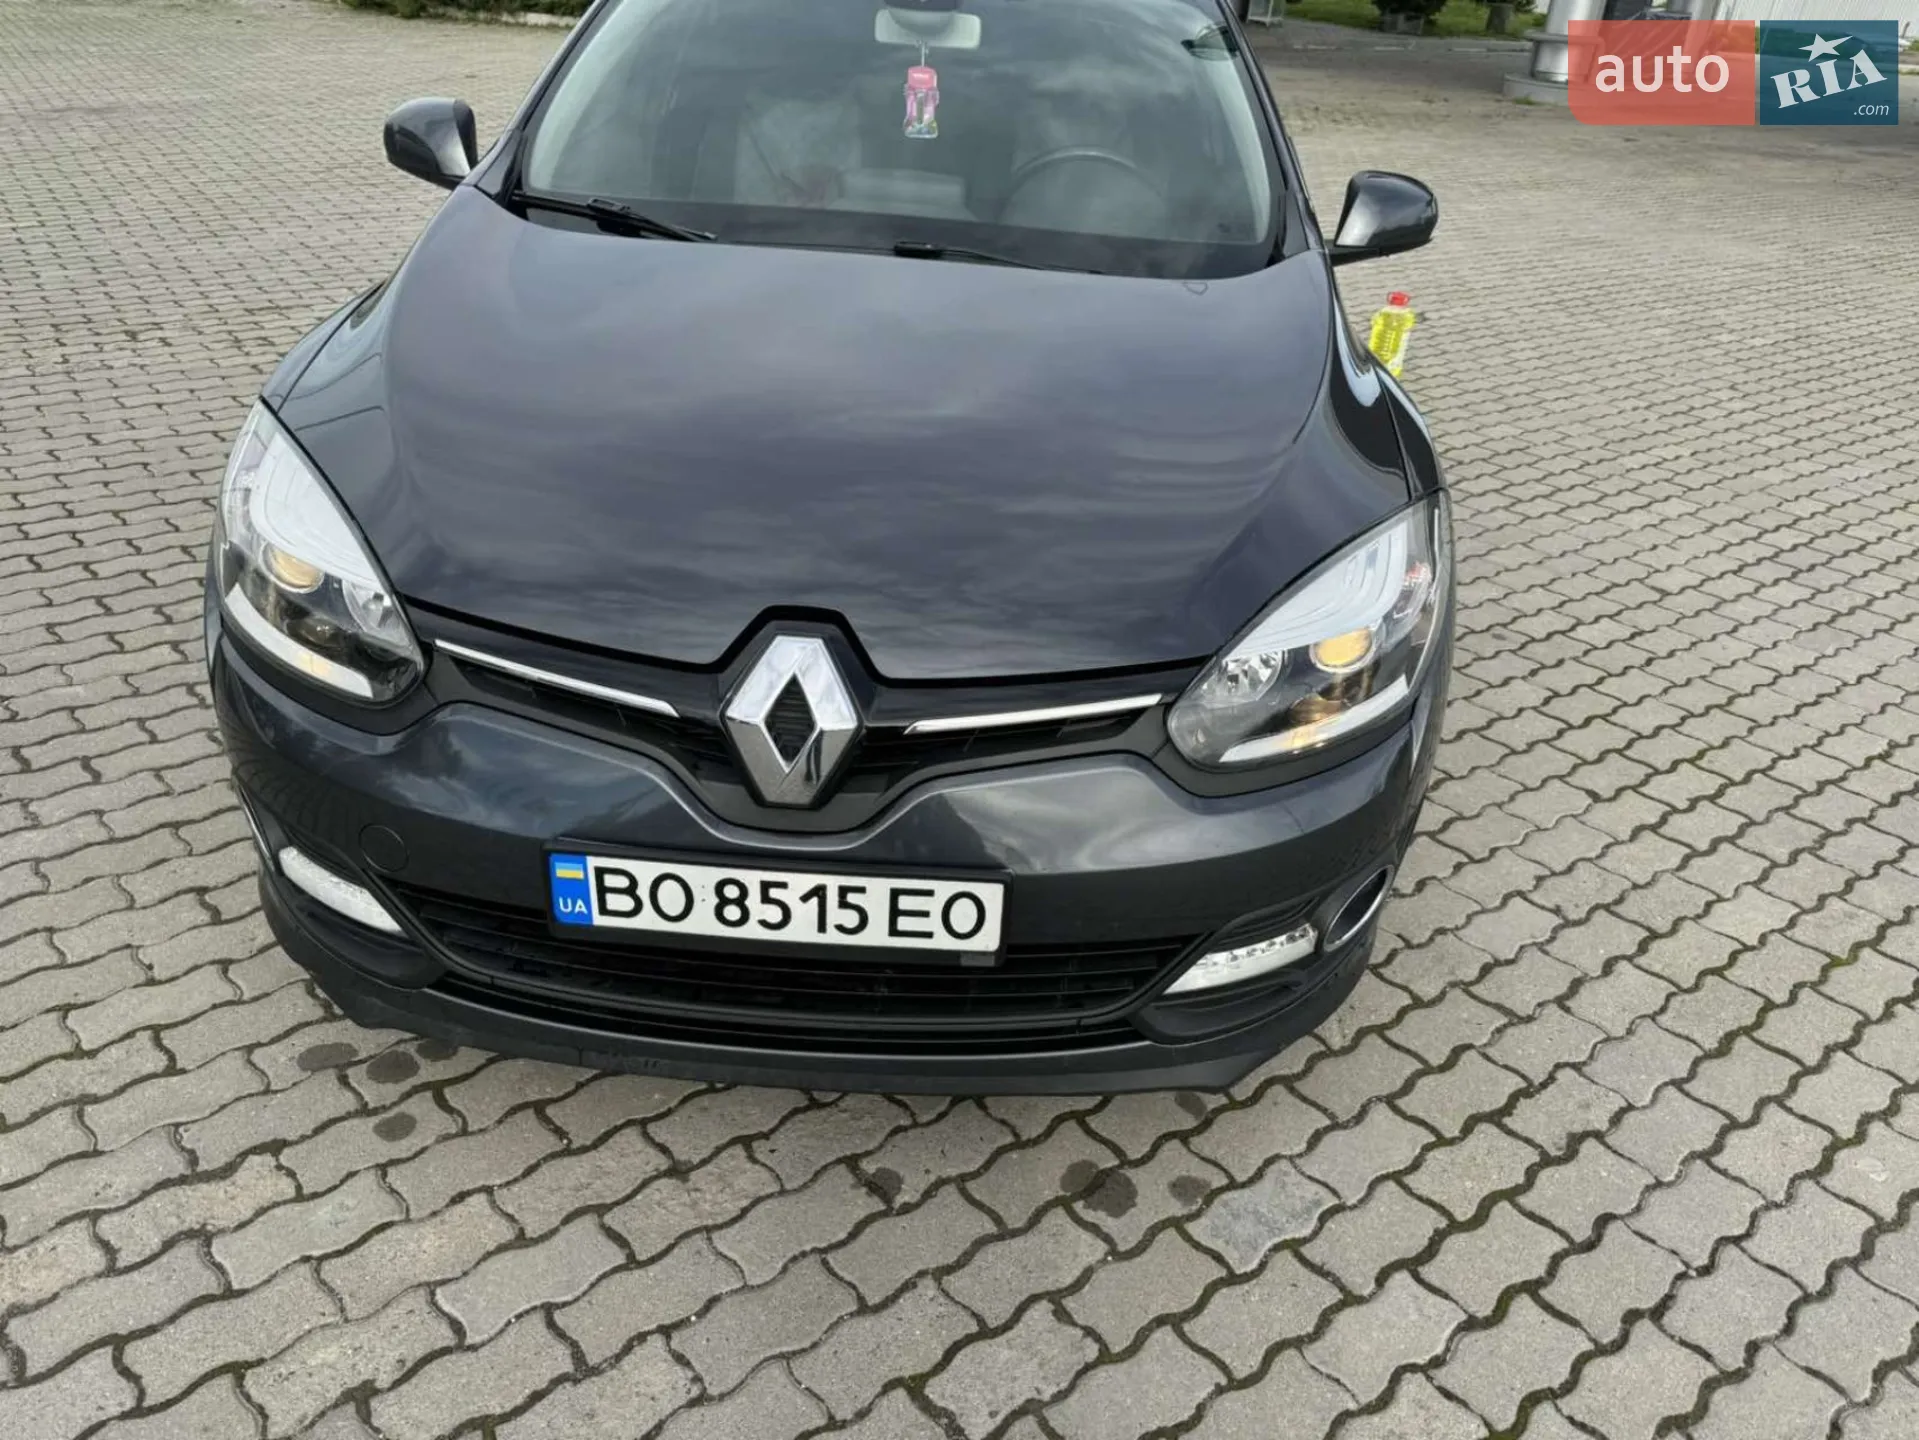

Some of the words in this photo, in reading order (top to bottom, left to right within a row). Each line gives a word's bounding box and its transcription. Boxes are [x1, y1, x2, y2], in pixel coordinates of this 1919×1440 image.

[559, 897, 588, 915] UA
[594, 866, 694, 923] BO
[714, 878, 869, 935] 8515
[888, 887, 986, 940] EO
